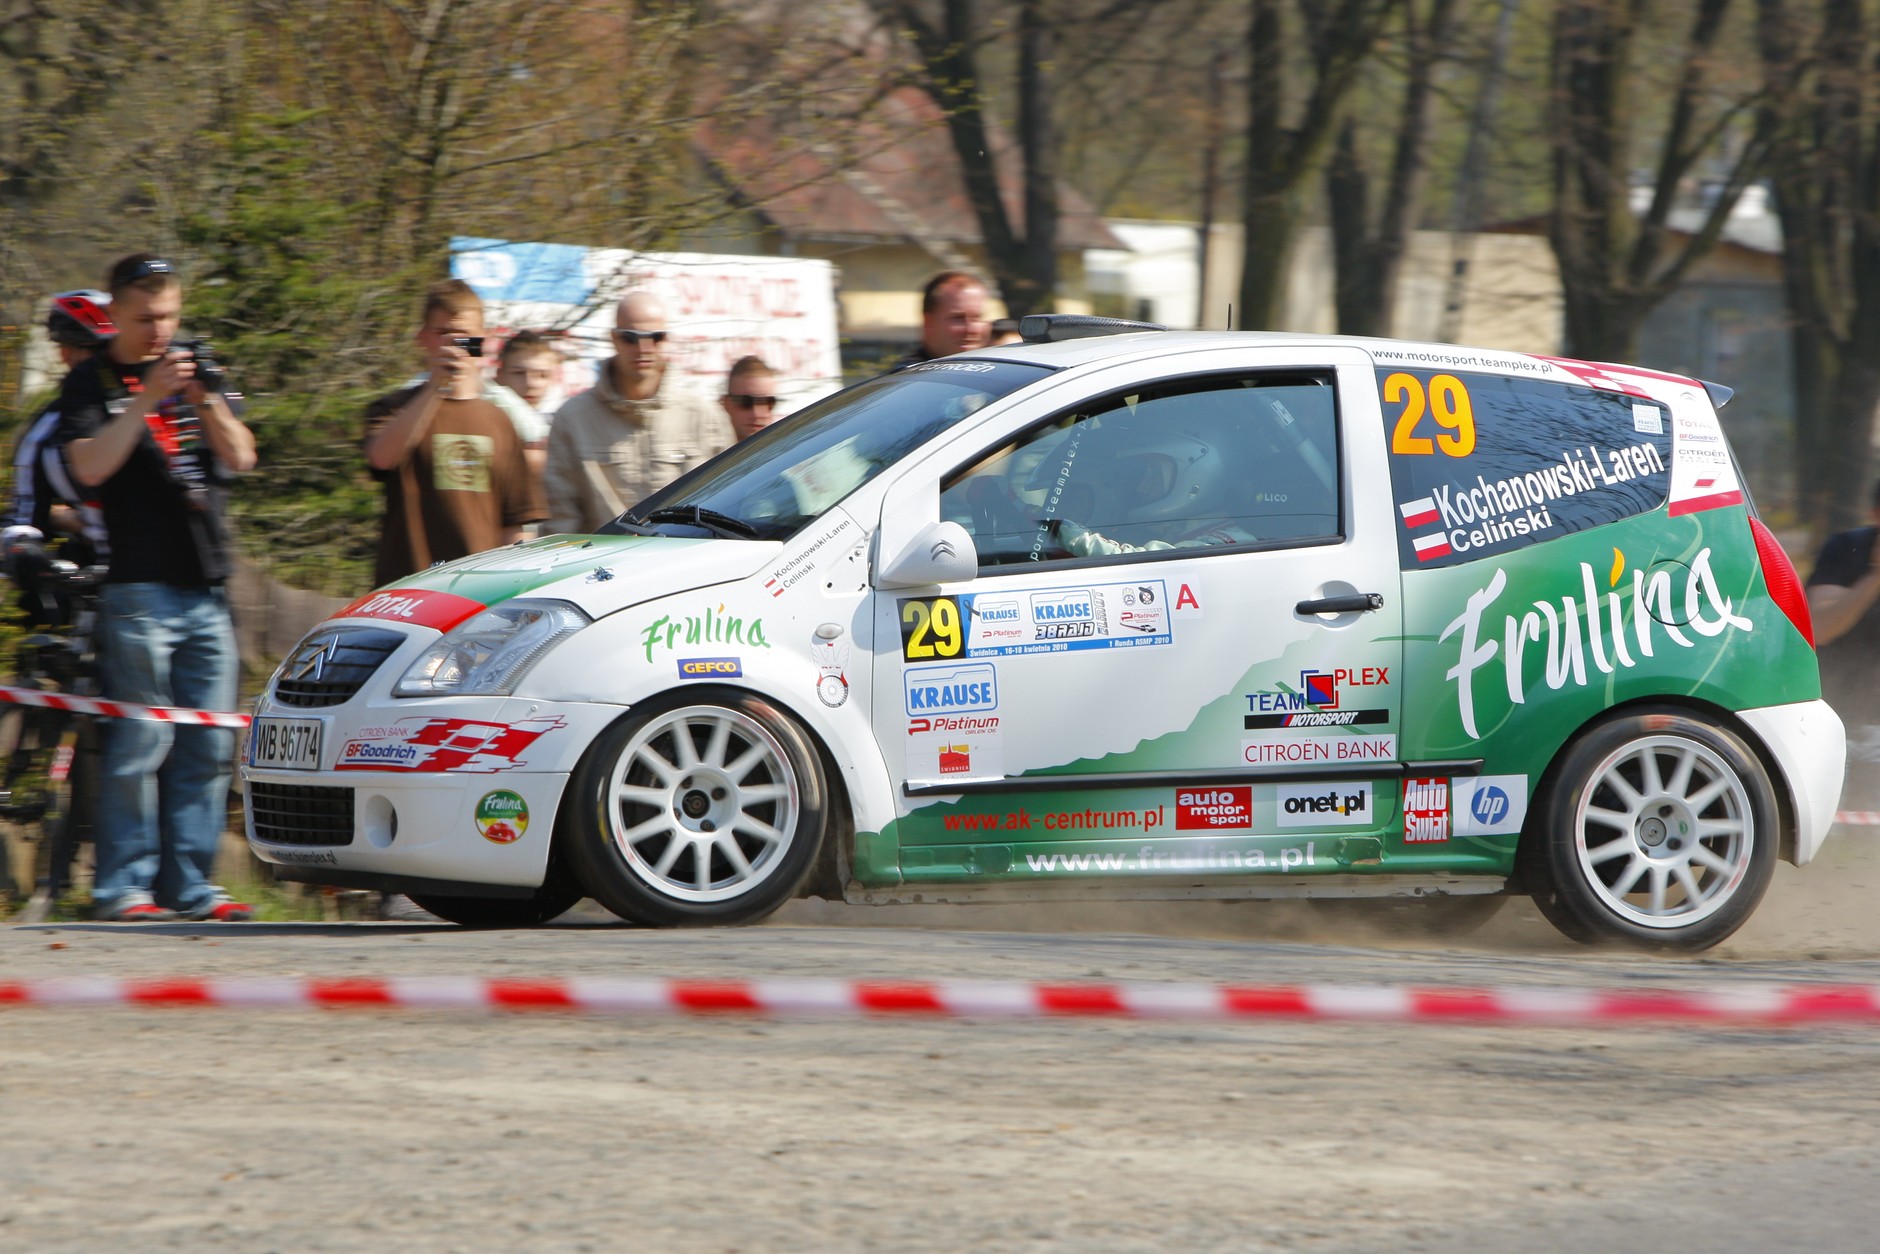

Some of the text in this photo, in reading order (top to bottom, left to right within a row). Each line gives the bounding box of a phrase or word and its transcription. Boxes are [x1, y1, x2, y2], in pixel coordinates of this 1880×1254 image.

[1371, 350, 1553, 375] www.motorsport.teamplex.pl
[1383, 372, 1476, 459] 29
[1431, 442, 1665, 530] Kochanowski-Laren
[1448, 505, 1553, 553] Celiński
[774, 519, 851, 579] Kochanowski-Laren
[354, 592, 424, 618] TOTAL
[1175, 583, 1199, 610] A
[981, 609, 1018, 621] KRAUSE
[1034, 602, 1091, 620] KRAUSE
[640, 602, 771, 664] Frulina
[903, 598, 961, 658] 29
[992, 629, 1023, 638] Platinum
[1005, 645, 1023, 654] 16-18
[1024, 644, 1051, 654] kwietnia
[1052, 643, 1068, 652] 2010
[1115, 640, 1134, 648] Runda
[1135, 638, 1154, 647] RSMP
[1154, 636, 1170, 645] 2010
[1437, 547, 1754, 740] Frulina
[683, 661, 737, 674] GEFCO
[1334, 667, 1390, 687] PLEX
[910, 682, 992, 710] KRAUSE
[1245, 693, 1305, 712] TEAM
[933, 716, 1000, 732] Platinum
[1289, 711, 1359, 727] MOTORSPORT
[257, 724, 277, 762] WB
[279, 725, 318, 763] 96774
[387, 727, 409, 737] BANK
[345, 743, 418, 762] BFGoodrich
[1244, 738, 1393, 763] CITROËN BANK
[484, 794, 524, 811] Frulina
[1178, 790, 1235, 806] auto
[1284, 789, 1366, 817] onet.pl
[1403, 778, 1448, 811] Auto
[1476, 786, 1505, 825] hp
[943, 804, 1164, 832] www.ak-centrum.pl
[1190, 804, 1245, 816] motor
[1209, 815, 1250, 826] sport
[1404, 810, 1449, 842] Świat
[1025, 841, 1315, 873] www.frulina.pl
